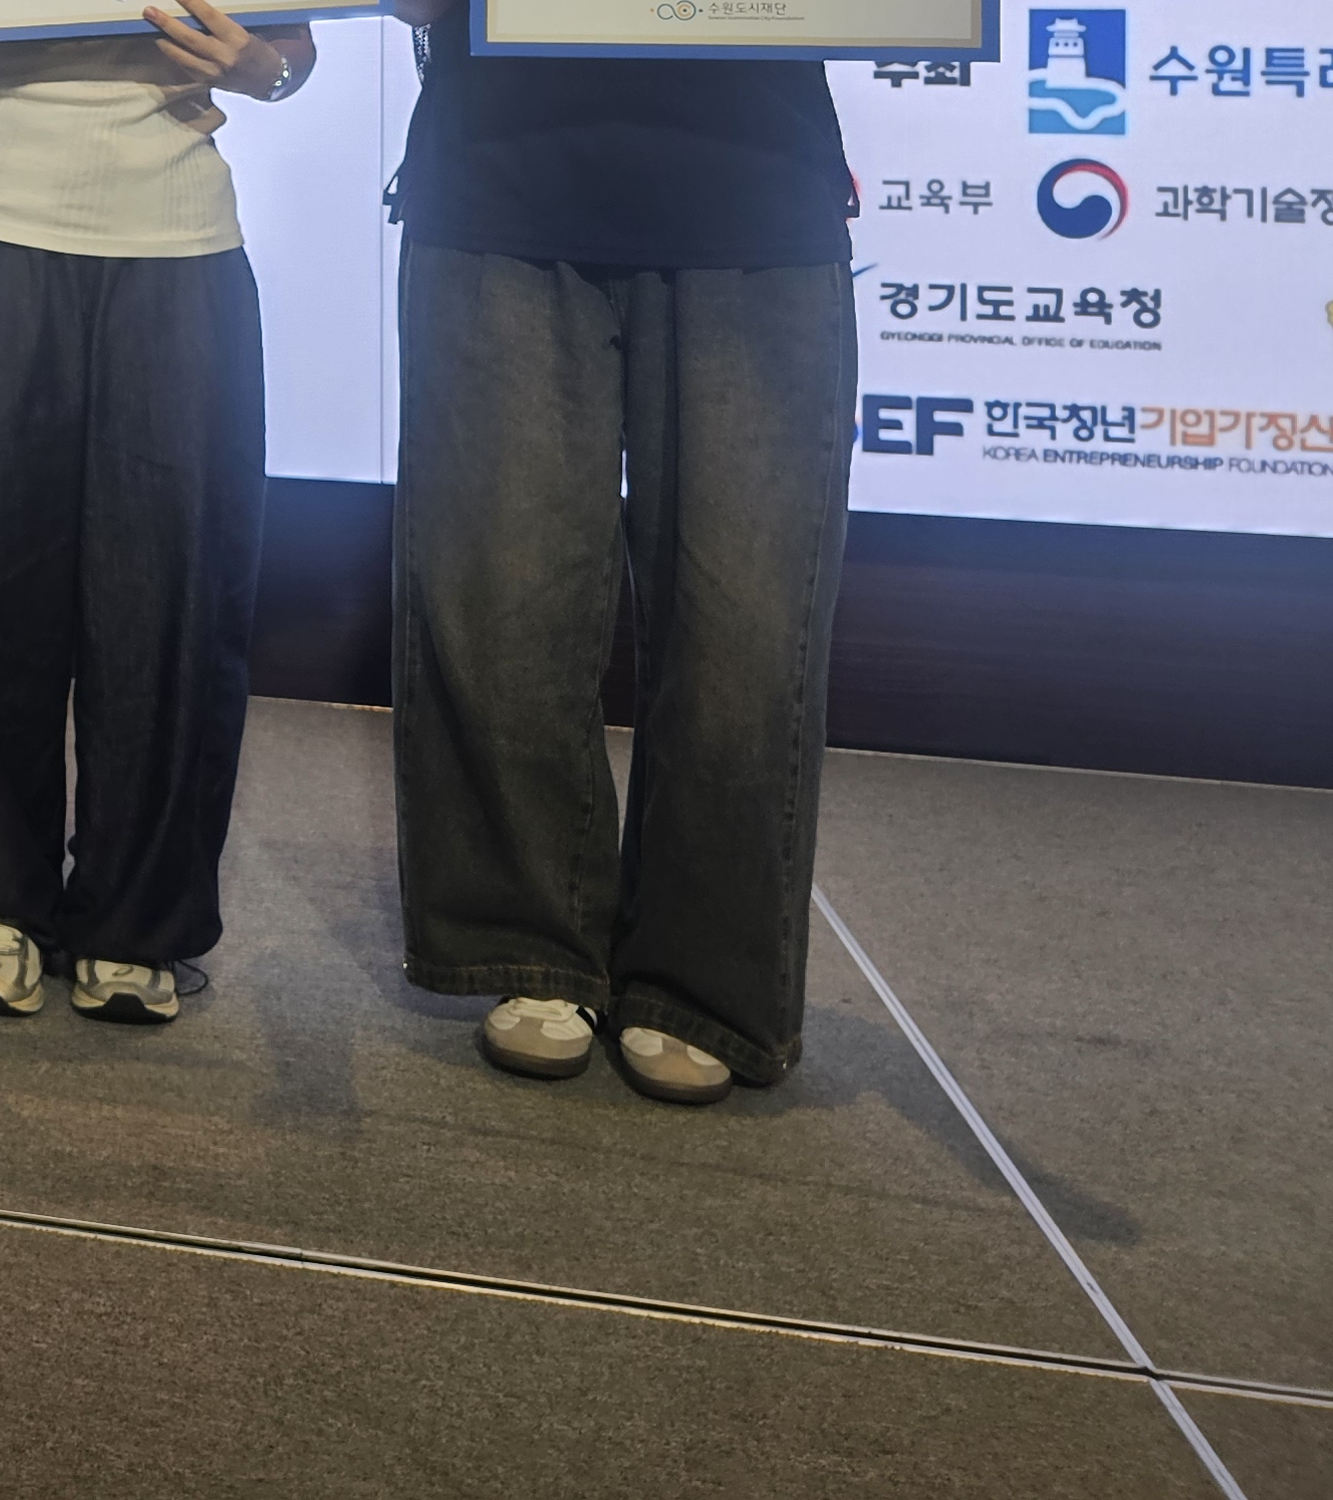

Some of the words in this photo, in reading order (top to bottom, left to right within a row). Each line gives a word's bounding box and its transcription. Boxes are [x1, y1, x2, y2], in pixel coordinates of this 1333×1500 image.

[708, 0, 788, 17] 수원도시재단
[878, 179, 994, 216] 교육부
[879, 282, 1163, 329] 경기도교육청
[1069, 337, 1086, 349] OF
[982, 445, 1039, 464] KOREA
[1043, 447, 1224, 472] ENTREPRENEURSHIP
